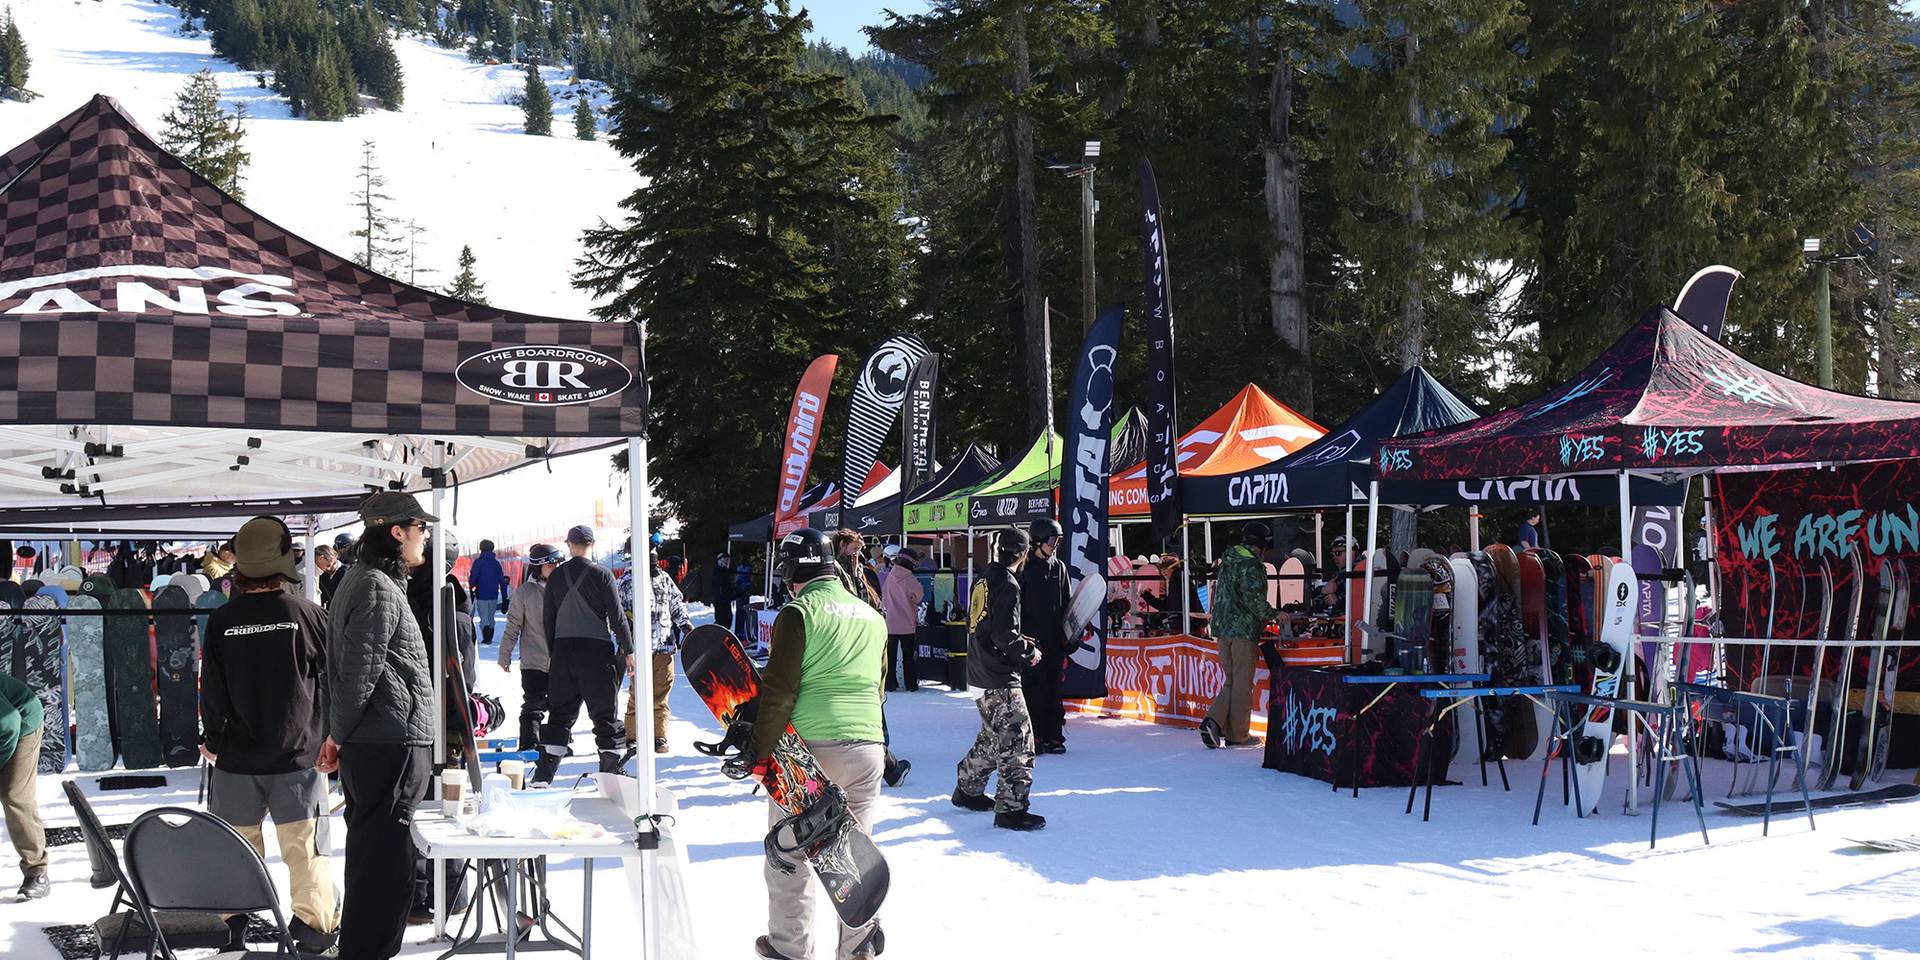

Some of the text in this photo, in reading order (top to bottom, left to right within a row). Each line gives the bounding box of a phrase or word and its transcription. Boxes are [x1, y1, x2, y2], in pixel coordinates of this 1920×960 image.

[0, 266, 301, 316] ANS
[482, 349, 608, 367] THE BOARDROOM
[478, 384, 608, 401] SNOW WAKE SKATE SURF
[1559, 434, 1605, 467] #YES
[1642, 425, 1705, 459] #YES
[1378, 447, 1413, 475] #YES
[1738, 514, 1780, 560] WE
[1793, 508, 1865, 561] ARE
[1641, 579, 1653, 618] APITA
[1105, 655, 1138, 692] NION
[1282, 687, 1337, 756] #YES
